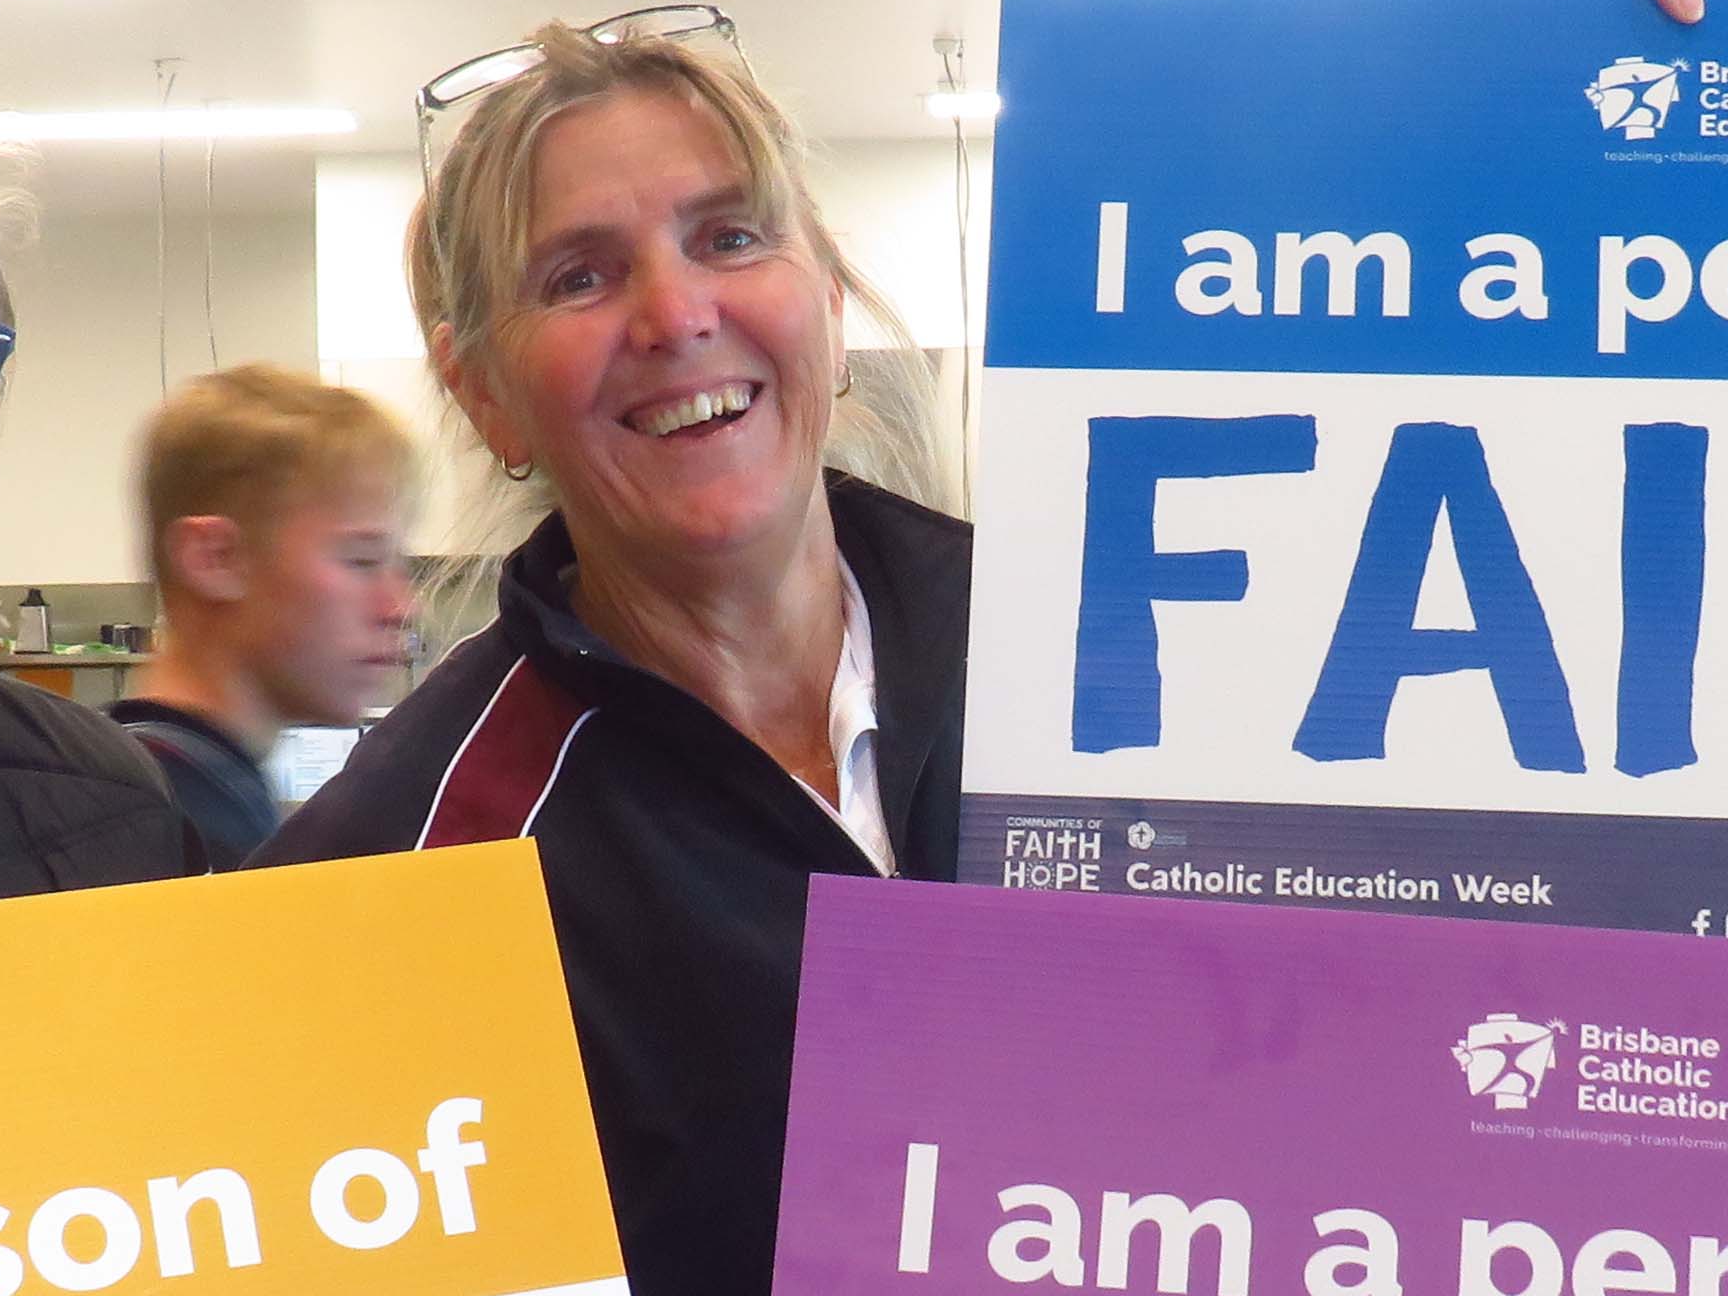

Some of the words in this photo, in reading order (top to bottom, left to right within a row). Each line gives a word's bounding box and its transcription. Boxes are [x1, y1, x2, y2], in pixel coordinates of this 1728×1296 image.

[1096, 202, 1128, 313] I
[1175, 229, 1411, 317] am
[1459, 233, 1549, 320] a
[1005, 815, 1084, 830] COMMUNITIES
[1086, 818, 1104, 831] OF
[1006, 829, 1101, 860] FAITH
[1003, 860, 1100, 892] HOPE
[1126, 862, 1263, 895] Catholic
[1275, 866, 1440, 901] Education
[1452, 873, 1553, 906] Week
[1580, 1023, 1721, 1059] Brisbane
[1578, 1054, 1712, 1088] Catholic
[309, 1096, 488, 1250] of
[898, 1142, 939, 1274] I
